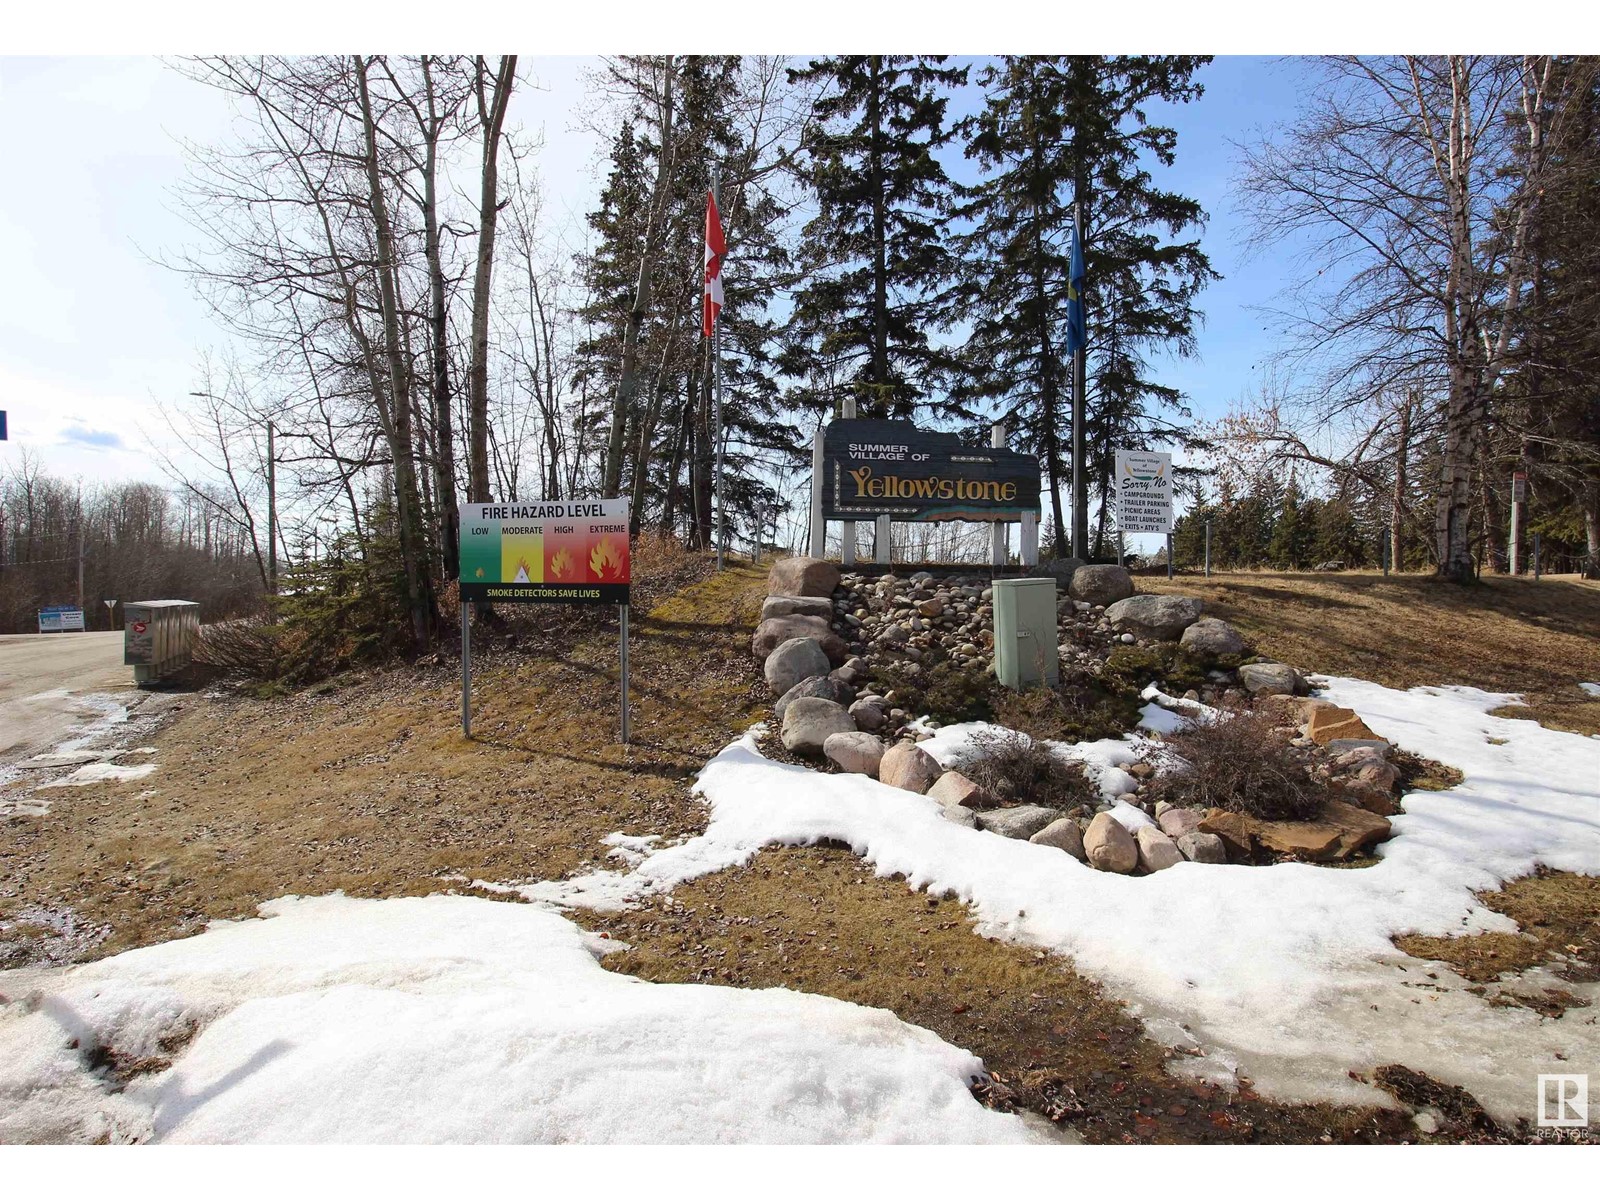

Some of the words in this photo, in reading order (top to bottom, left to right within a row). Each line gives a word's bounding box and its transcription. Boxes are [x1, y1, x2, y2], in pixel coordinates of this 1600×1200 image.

[848, 443, 908, 453] SUMMER
[848, 452, 905, 461] VILLAGE
[911, 453, 930, 462] OF
[848, 465, 1017, 502] Yellowstone
[1153, 476, 1167, 488] No
[1124, 491, 1164, 499] CAMPGROUNDS
[482, 507, 509, 520] FIRE
[511, 505, 565, 519] HAZARD
[568, 504, 606, 517] LEVEL
[471, 527, 489, 535] LOW
[501, 526, 543, 535] MODERATE
[554, 526, 574, 534] HIGH
[590, 525, 626, 533] EXTREME
[487, 588, 513, 597] SMOKE
[514, 588, 557, 597] DETECTORS
[558, 589, 578, 597] SAVE
[579, 589, 600, 598] LIVES
